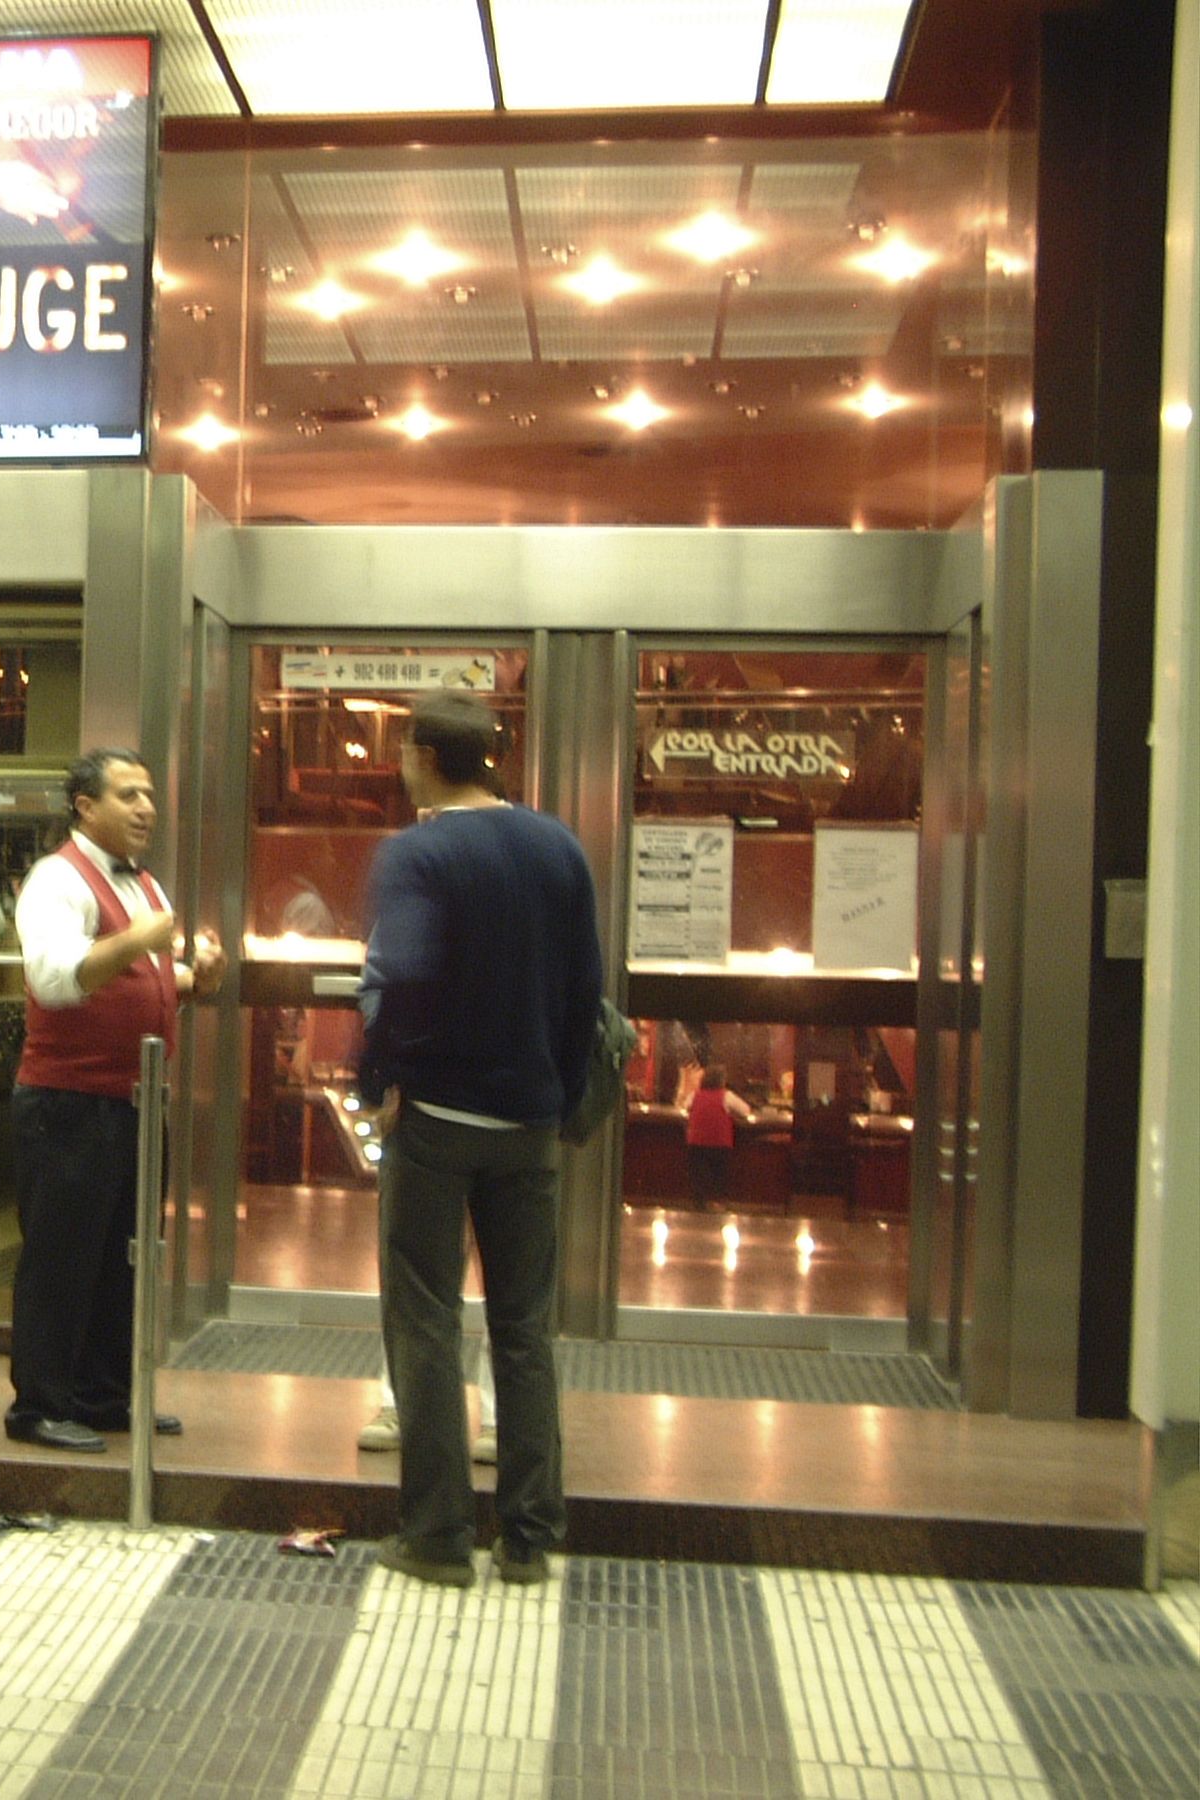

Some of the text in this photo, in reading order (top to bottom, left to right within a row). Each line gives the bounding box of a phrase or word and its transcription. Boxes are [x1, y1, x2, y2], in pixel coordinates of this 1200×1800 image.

[666, 730, 844, 756] POR LA OTRA
[712, 752, 850, 778] ENTRADA
